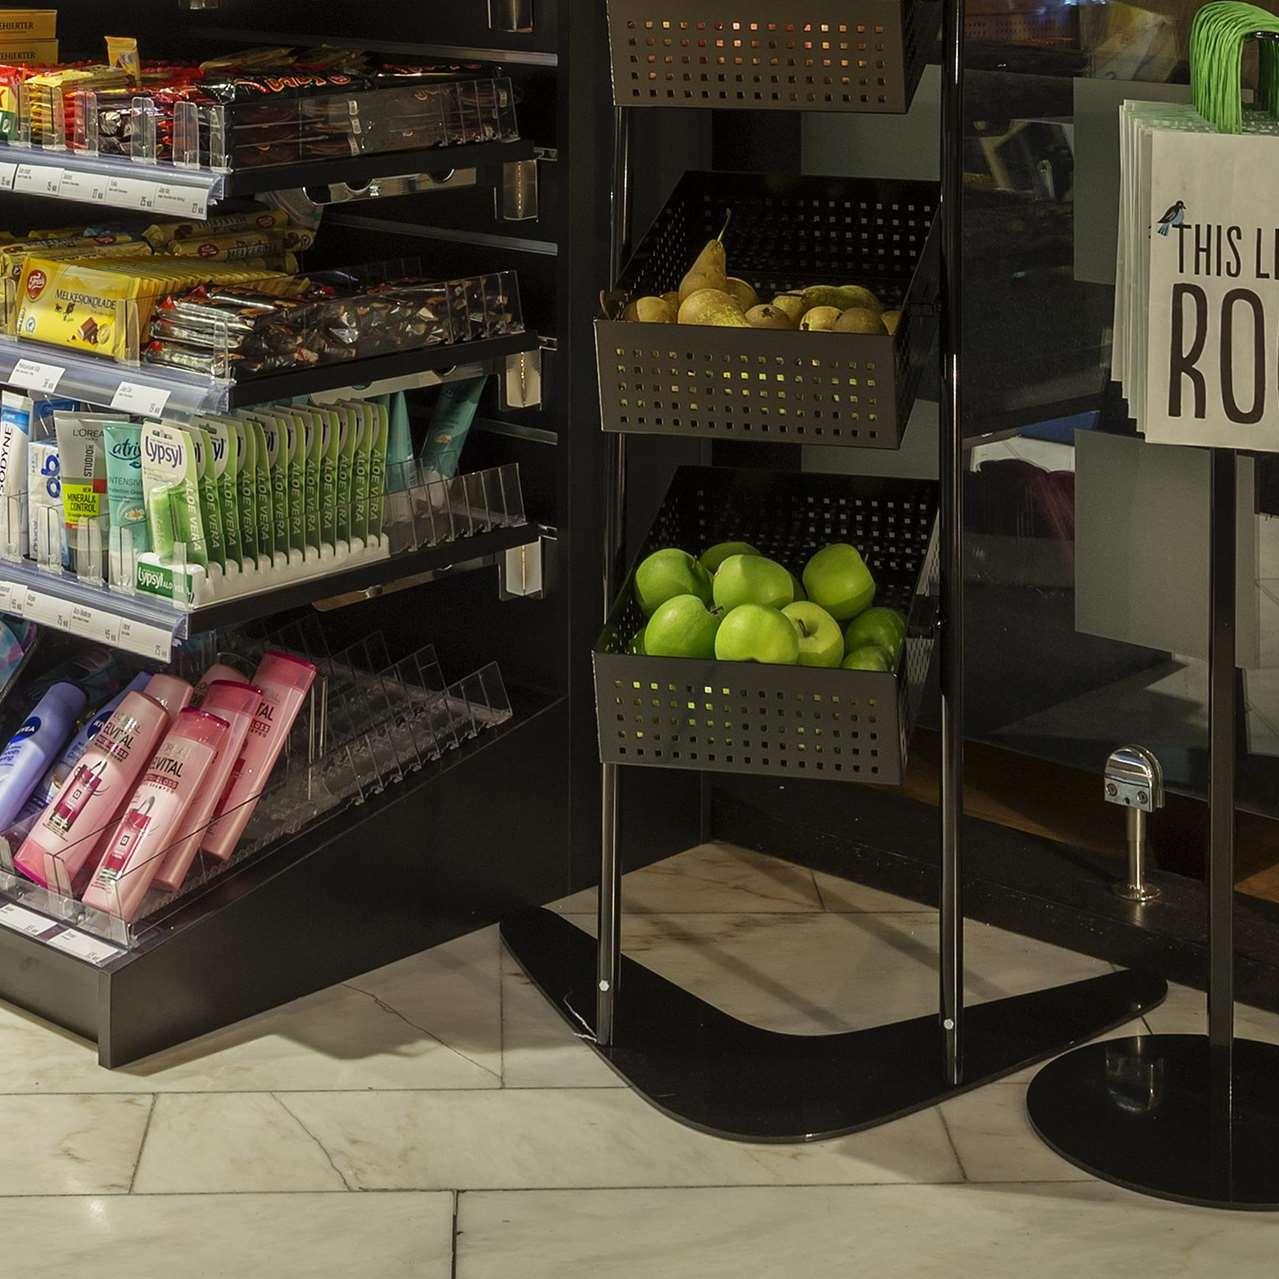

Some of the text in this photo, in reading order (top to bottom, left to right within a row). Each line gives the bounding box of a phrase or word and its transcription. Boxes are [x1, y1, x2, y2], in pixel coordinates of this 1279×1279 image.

[1172, 224, 1241, 277] THIS
[54, 288, 118, 311] MELKESJOKOLADE
[145, 436, 183, 468] Lypsyl
[355, 450, 365, 521] ALOE VERA
[370, 449, 382, 520] ALOE VERA
[204, 475, 220, 548] ALOE VERA
[223, 472, 237, 546] ALOE VERA
[242, 470, 253, 543] ALOE VERA
[257, 467, 269, 541] ALOE VERA
[275, 464, 285, 537] ALOE VERA
[291, 462, 301, 534] ALOE VERA
[307, 459, 316, 532] ALOE VERA
[323, 456, 333, 529] ALOE VERA
[338, 454, 348, 526] ALOE VERA
[190, 516, 202, 551] VERA
[138, 567, 163, 589] Lypsyl
